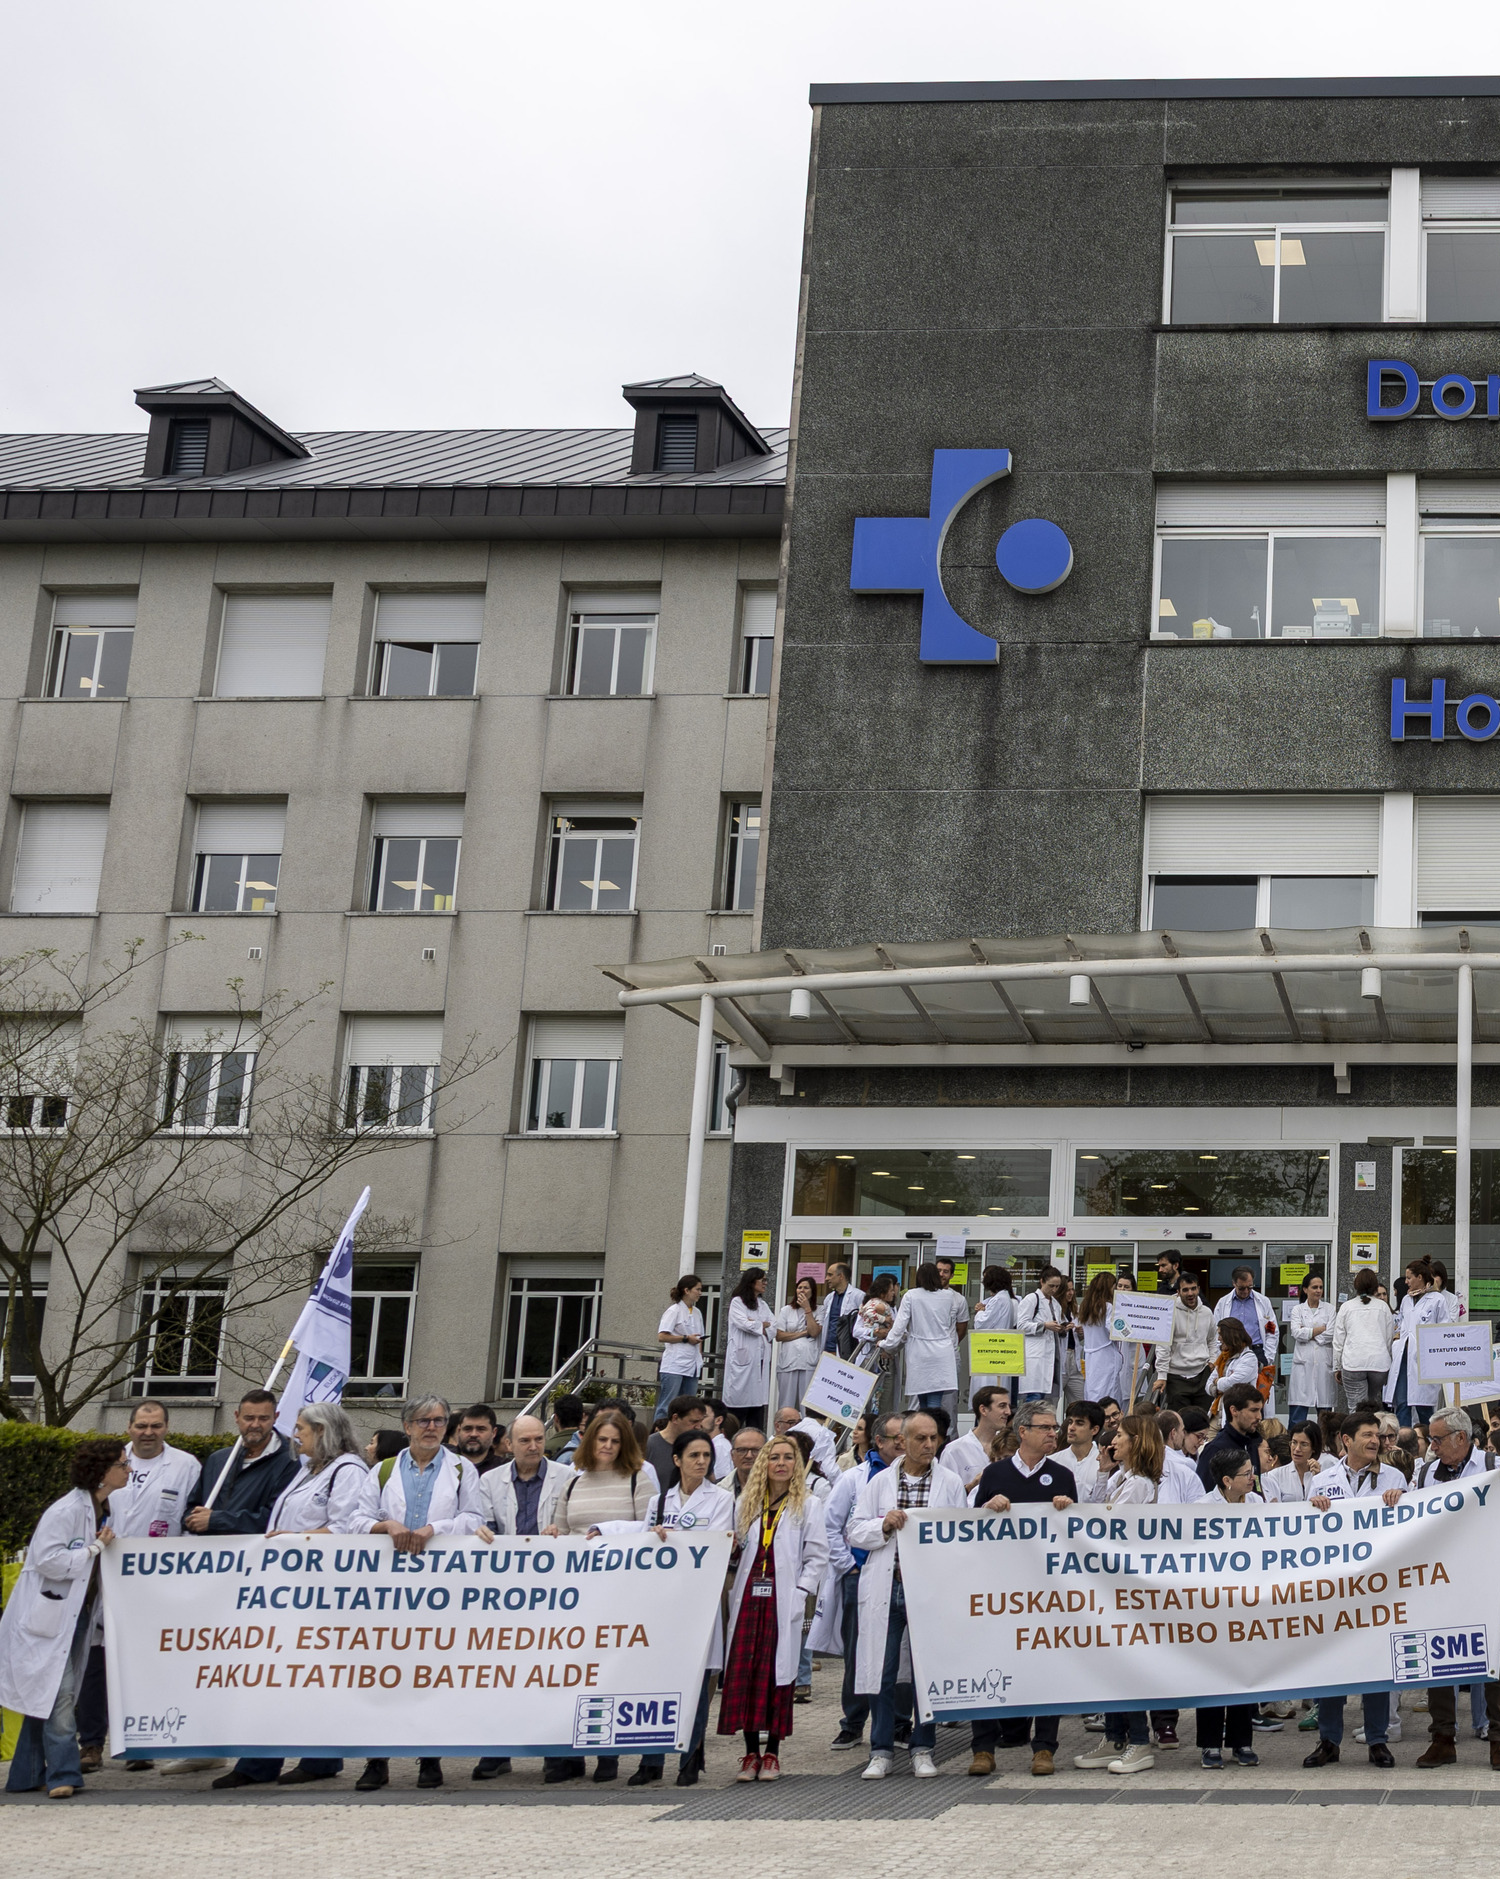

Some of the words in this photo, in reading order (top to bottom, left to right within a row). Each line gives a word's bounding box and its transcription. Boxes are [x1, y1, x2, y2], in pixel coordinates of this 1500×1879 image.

[920, 1517, 1056, 1544] EUSKADI,
[1068, 1517, 1128, 1540] POR
[1138, 1519, 1182, 1540] UN
[1194, 1513, 1342, 1540] ESTATUTO
[1473, 1485, 1490, 1506] Y
[122, 1551, 251, 1576] EUSKADI,
[261, 1549, 323, 1572] POR
[335, 1550, 380, 1572] UN
[391, 1546, 554, 1573] ESTATUTO
[566, 1544, 677, 1573] MÉDICO
[689, 1546, 709, 1568] Y
[1047, 1552, 1250, 1575] FACULTATIVO
[1262, 1542, 1372, 1570] PROPIO
[237, 1586, 450, 1610] FACULTATIVO
[462, 1587, 579, 1610] PROPIO
[971, 1590, 1103, 1616] EUSKADI,
[1116, 1587, 1259, 1610] ESTATUTU
[1272, 1573, 1389, 1606] MEDIKO
[1399, 1562, 1450, 1588] ETA
[160, 1626, 282, 1653] EUSKADI,
[297, 1627, 456, 1650] ESTATUTU
[467, 1626, 585, 1650] MEDIKO
[596, 1625, 649, 1648] ETA
[1017, 1622, 1217, 1650] FAKULTATIBO
[1229, 1614, 1323, 1642] BATEN
[1334, 1602, 1407, 1632] ALDE
[1431, 1633, 1485, 1659] SME
[196, 1664, 401, 1688] FAKULTATIBO
[413, 1665, 516, 1688] BATEN
[524, 1664, 599, 1687] ALDE
[617, 1701, 677, 1726] SME
